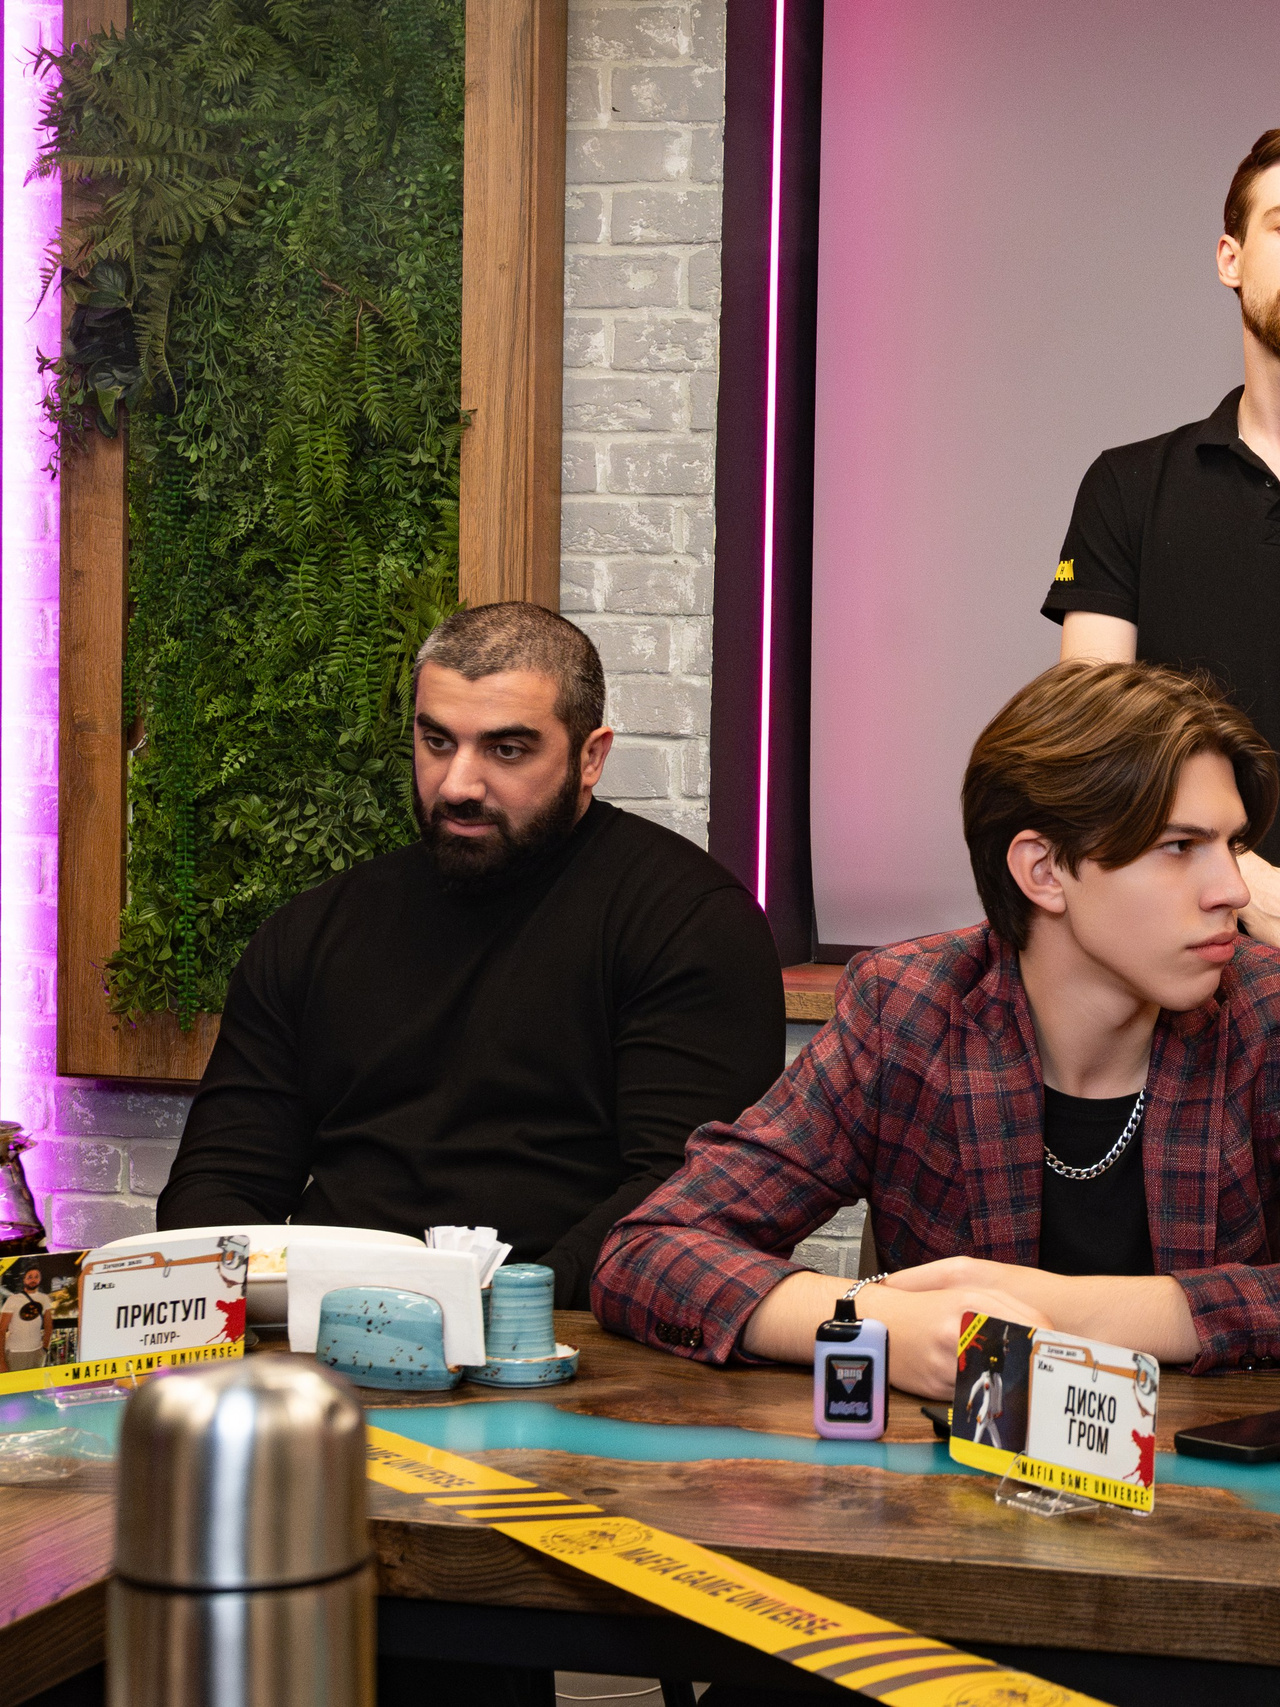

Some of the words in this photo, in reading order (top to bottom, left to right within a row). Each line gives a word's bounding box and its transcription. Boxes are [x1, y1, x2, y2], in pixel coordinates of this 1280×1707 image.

[116, 1297, 206, 1329] ПРИСТУП
[139, 1332, 181, 1346] -ГАПУР-
[72, 1361, 118, 1380] MAFIA
[171, 1345, 233, 1366] UNIVERSE
[1065, 1385, 1117, 1424] ДИСКО
[1068, 1418, 1109, 1455] ГРОМ
[382, 1458, 475, 1488] UNIVERSE
[1021, 1461, 1054, 1482] MAFIA
[1061, 1471, 1088, 1491] GAME
[1094, 1481, 1144, 1505] UNIVERSE
[614, 1547, 688, 1576] MAFIA
[672, 1570, 743, 1597] GAME
[725, 1590, 841, 1636] UNIVERSE
